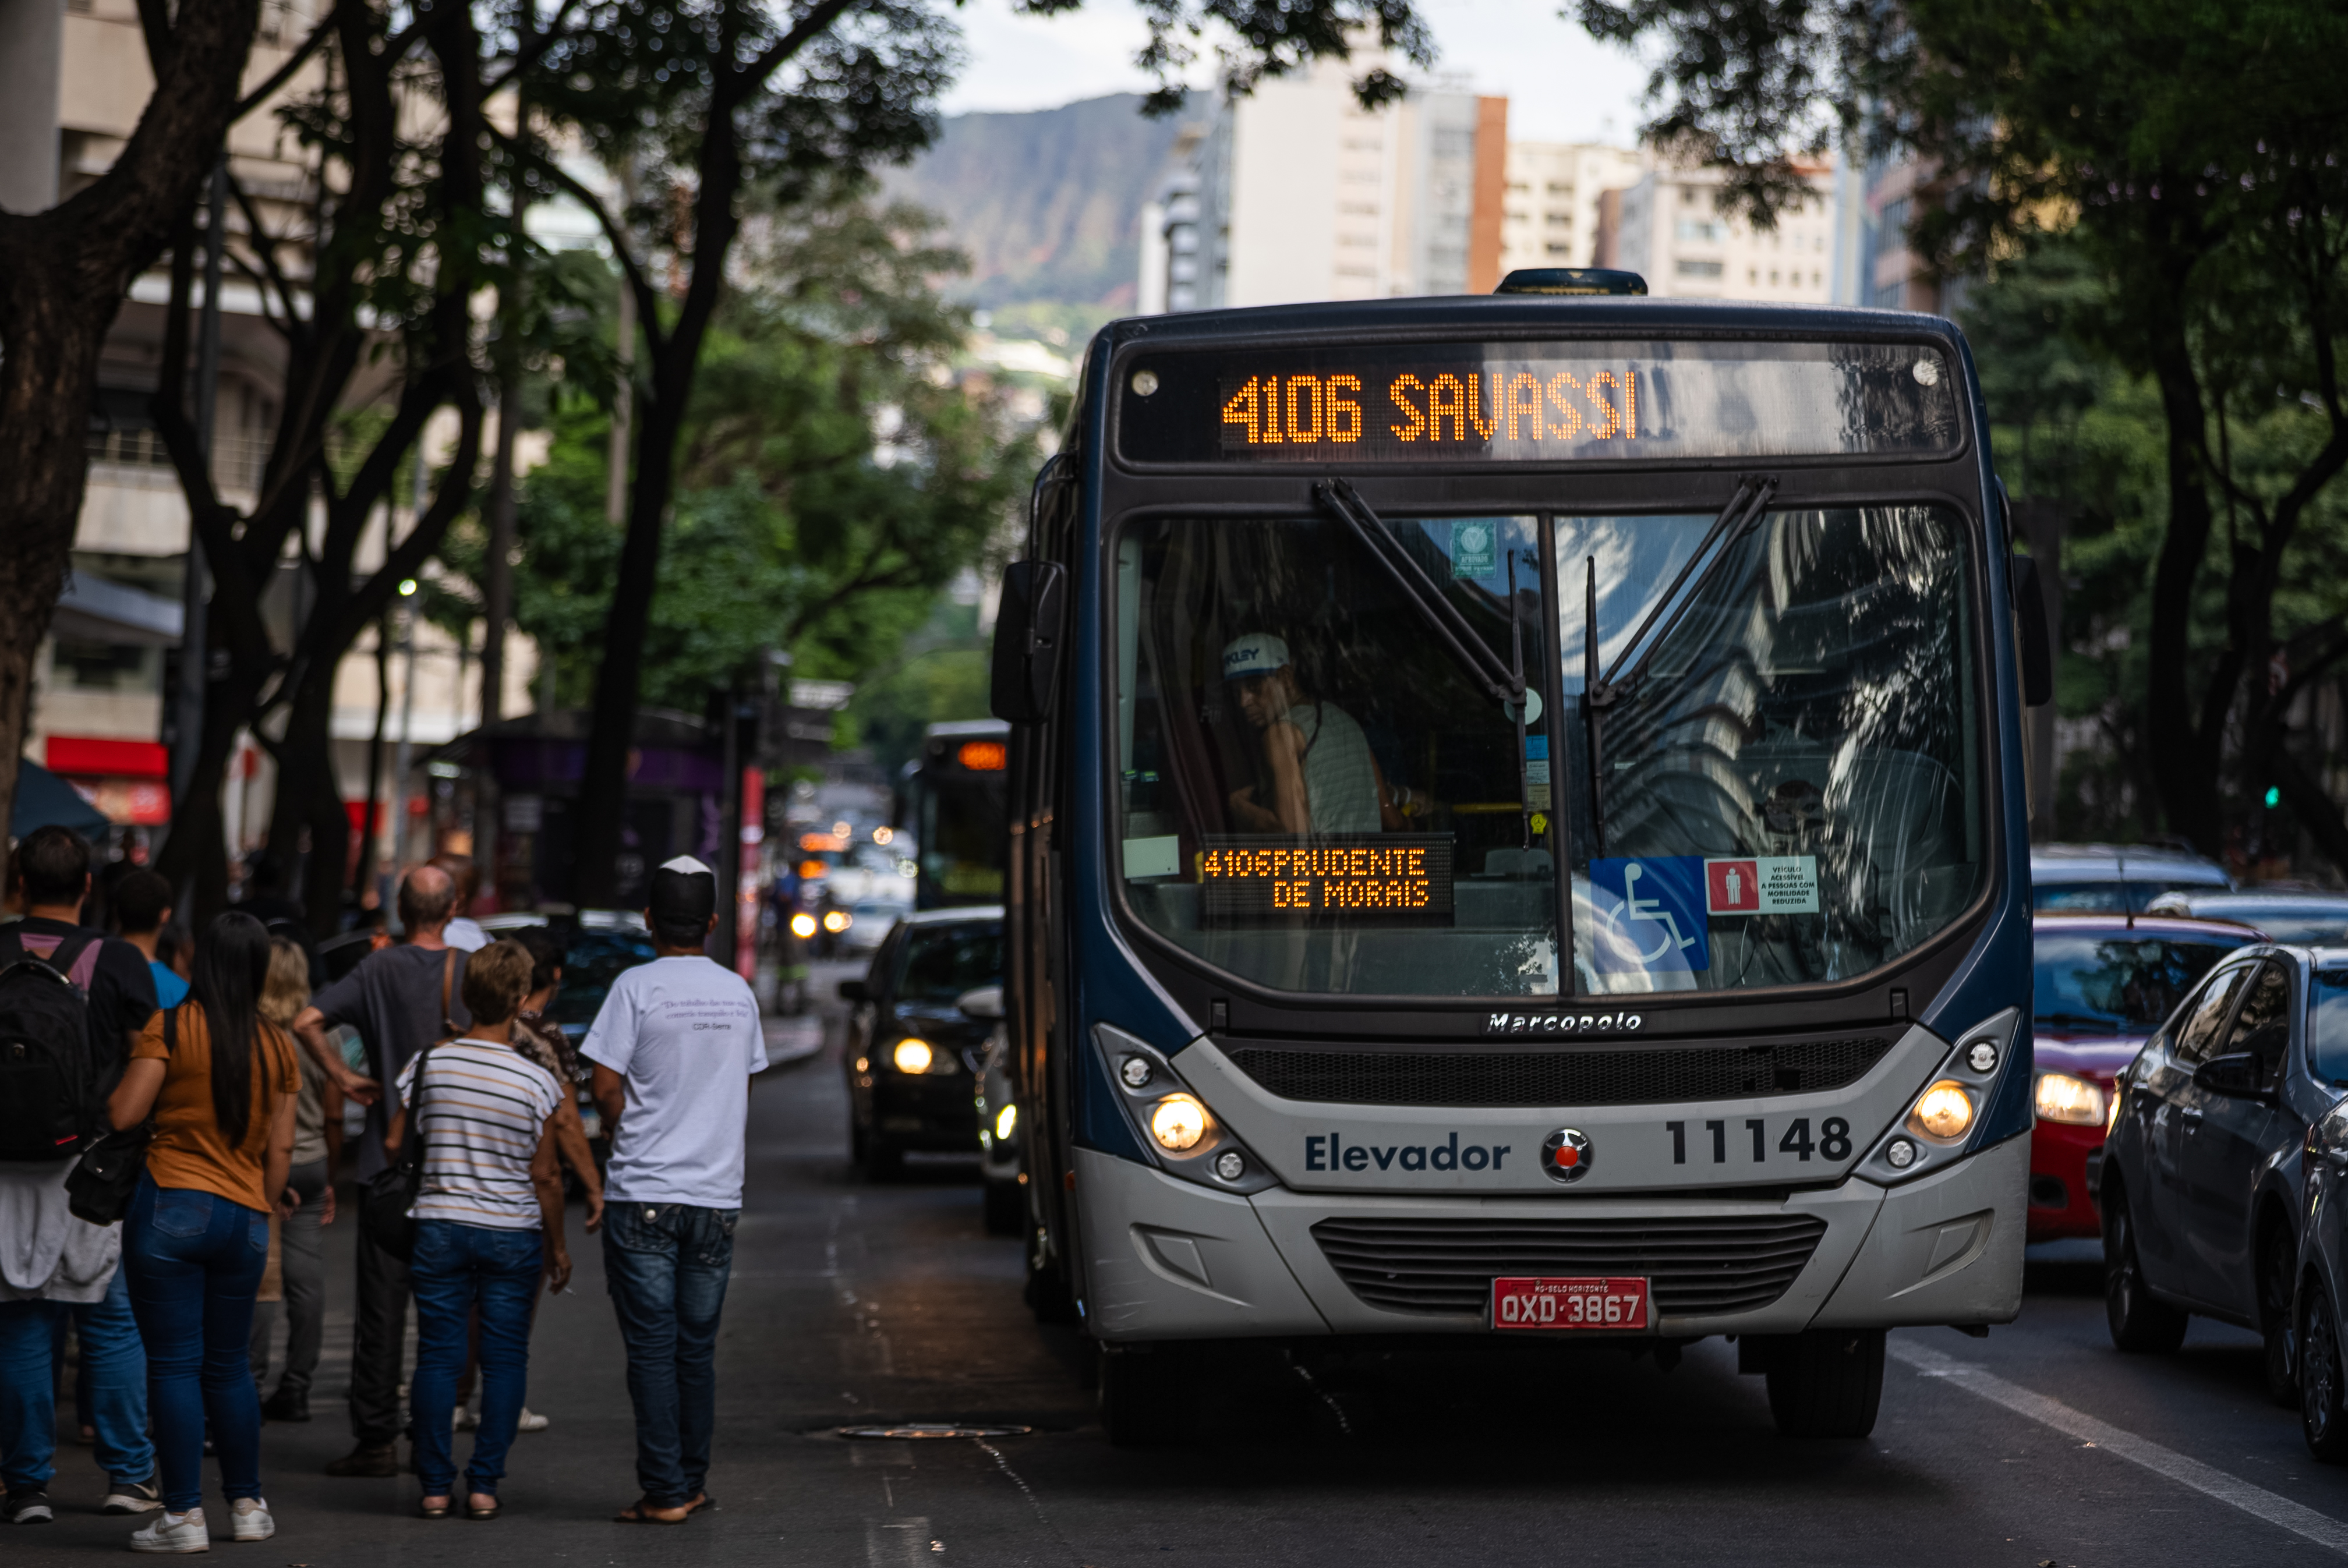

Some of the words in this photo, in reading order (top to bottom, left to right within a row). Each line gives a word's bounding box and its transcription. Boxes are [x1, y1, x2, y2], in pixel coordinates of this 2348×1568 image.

[1222, 374, 1362, 444] 4106
[1389, 371, 1636, 442] SAVASSI
[1461, 555, 1488, 563] APROVADO
[1274, 880, 1311, 908] DE
[1324, 880, 1429, 907] MORAIS
[1486, 1011, 1642, 1033] Marcopolo
[1304, 1131, 1512, 1173] Elevador
[1664, 1116, 1853, 1165] 11148
[1568, 1284, 1609, 1293] HORIZONTE
